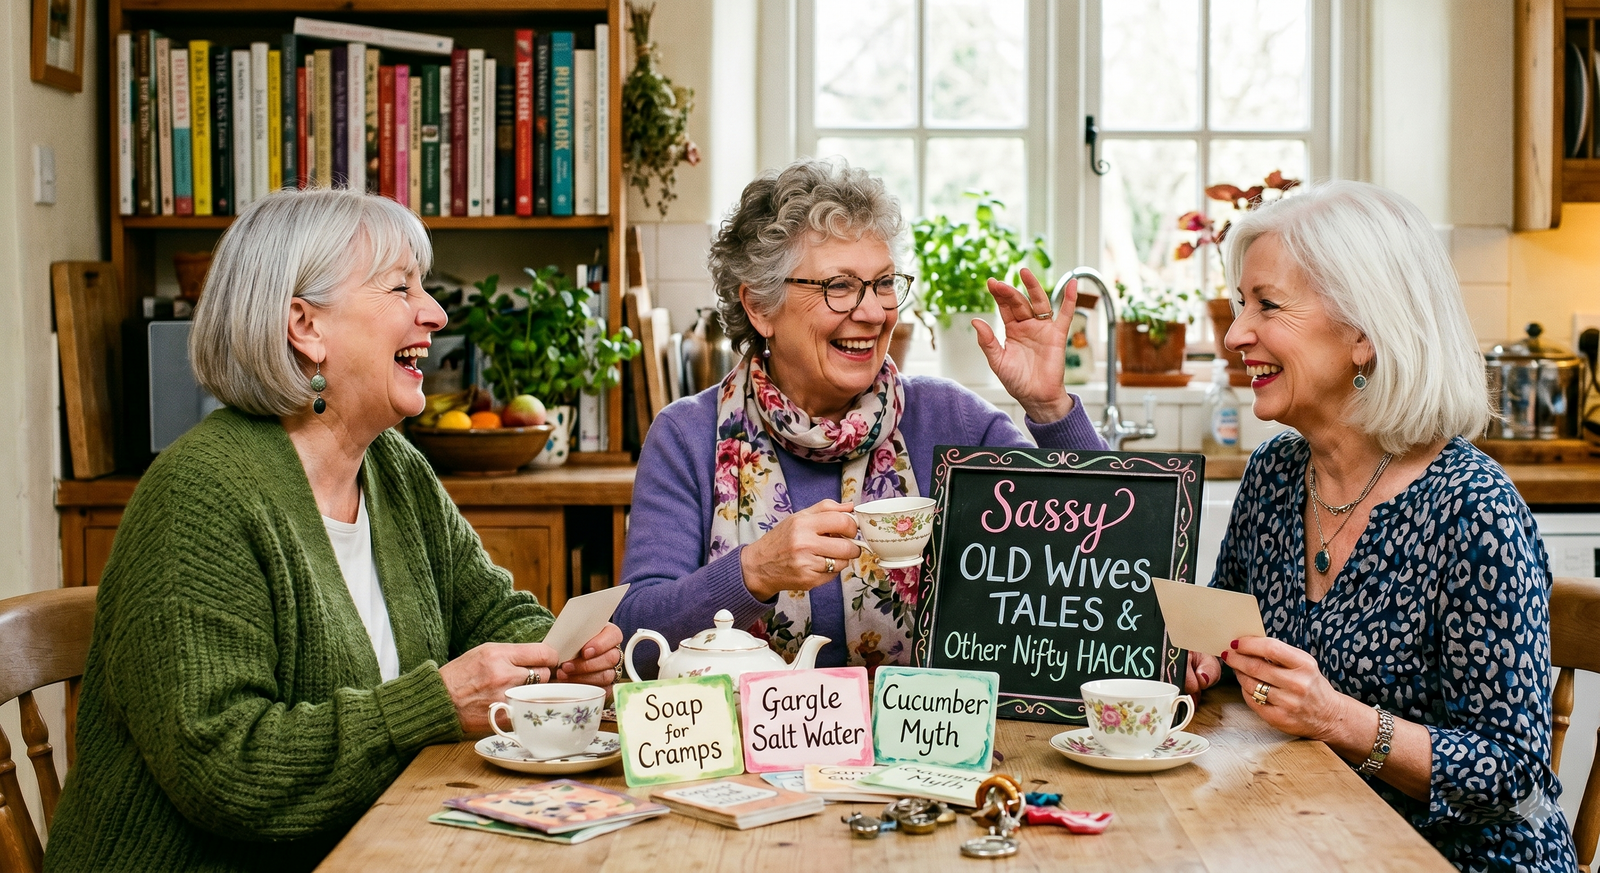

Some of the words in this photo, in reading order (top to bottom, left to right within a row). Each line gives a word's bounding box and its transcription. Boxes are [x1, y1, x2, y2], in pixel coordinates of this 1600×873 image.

[981, 479, 1136, 554] Sassy
[959, 542, 1032, 583] OLD
[1044, 544, 1151, 593] Wives
[989, 591, 1104, 632] TALES
[1116, 599, 1143, 631] &
[944, 630, 1007, 662] Other
[1012, 634, 1069, 682] Nifty
[1076, 638, 1156, 678] HACKS
[644, 694, 703, 726] Soap
[762, 684, 842, 722] Gargle
[882, 683, 989, 715] Cucumber
[665, 723, 690, 745] for
[752, 722, 798, 752] Salt
[802, 720, 865, 748] Water
[900, 718, 960, 756] Myth
[638, 740, 722, 769] Cramps
